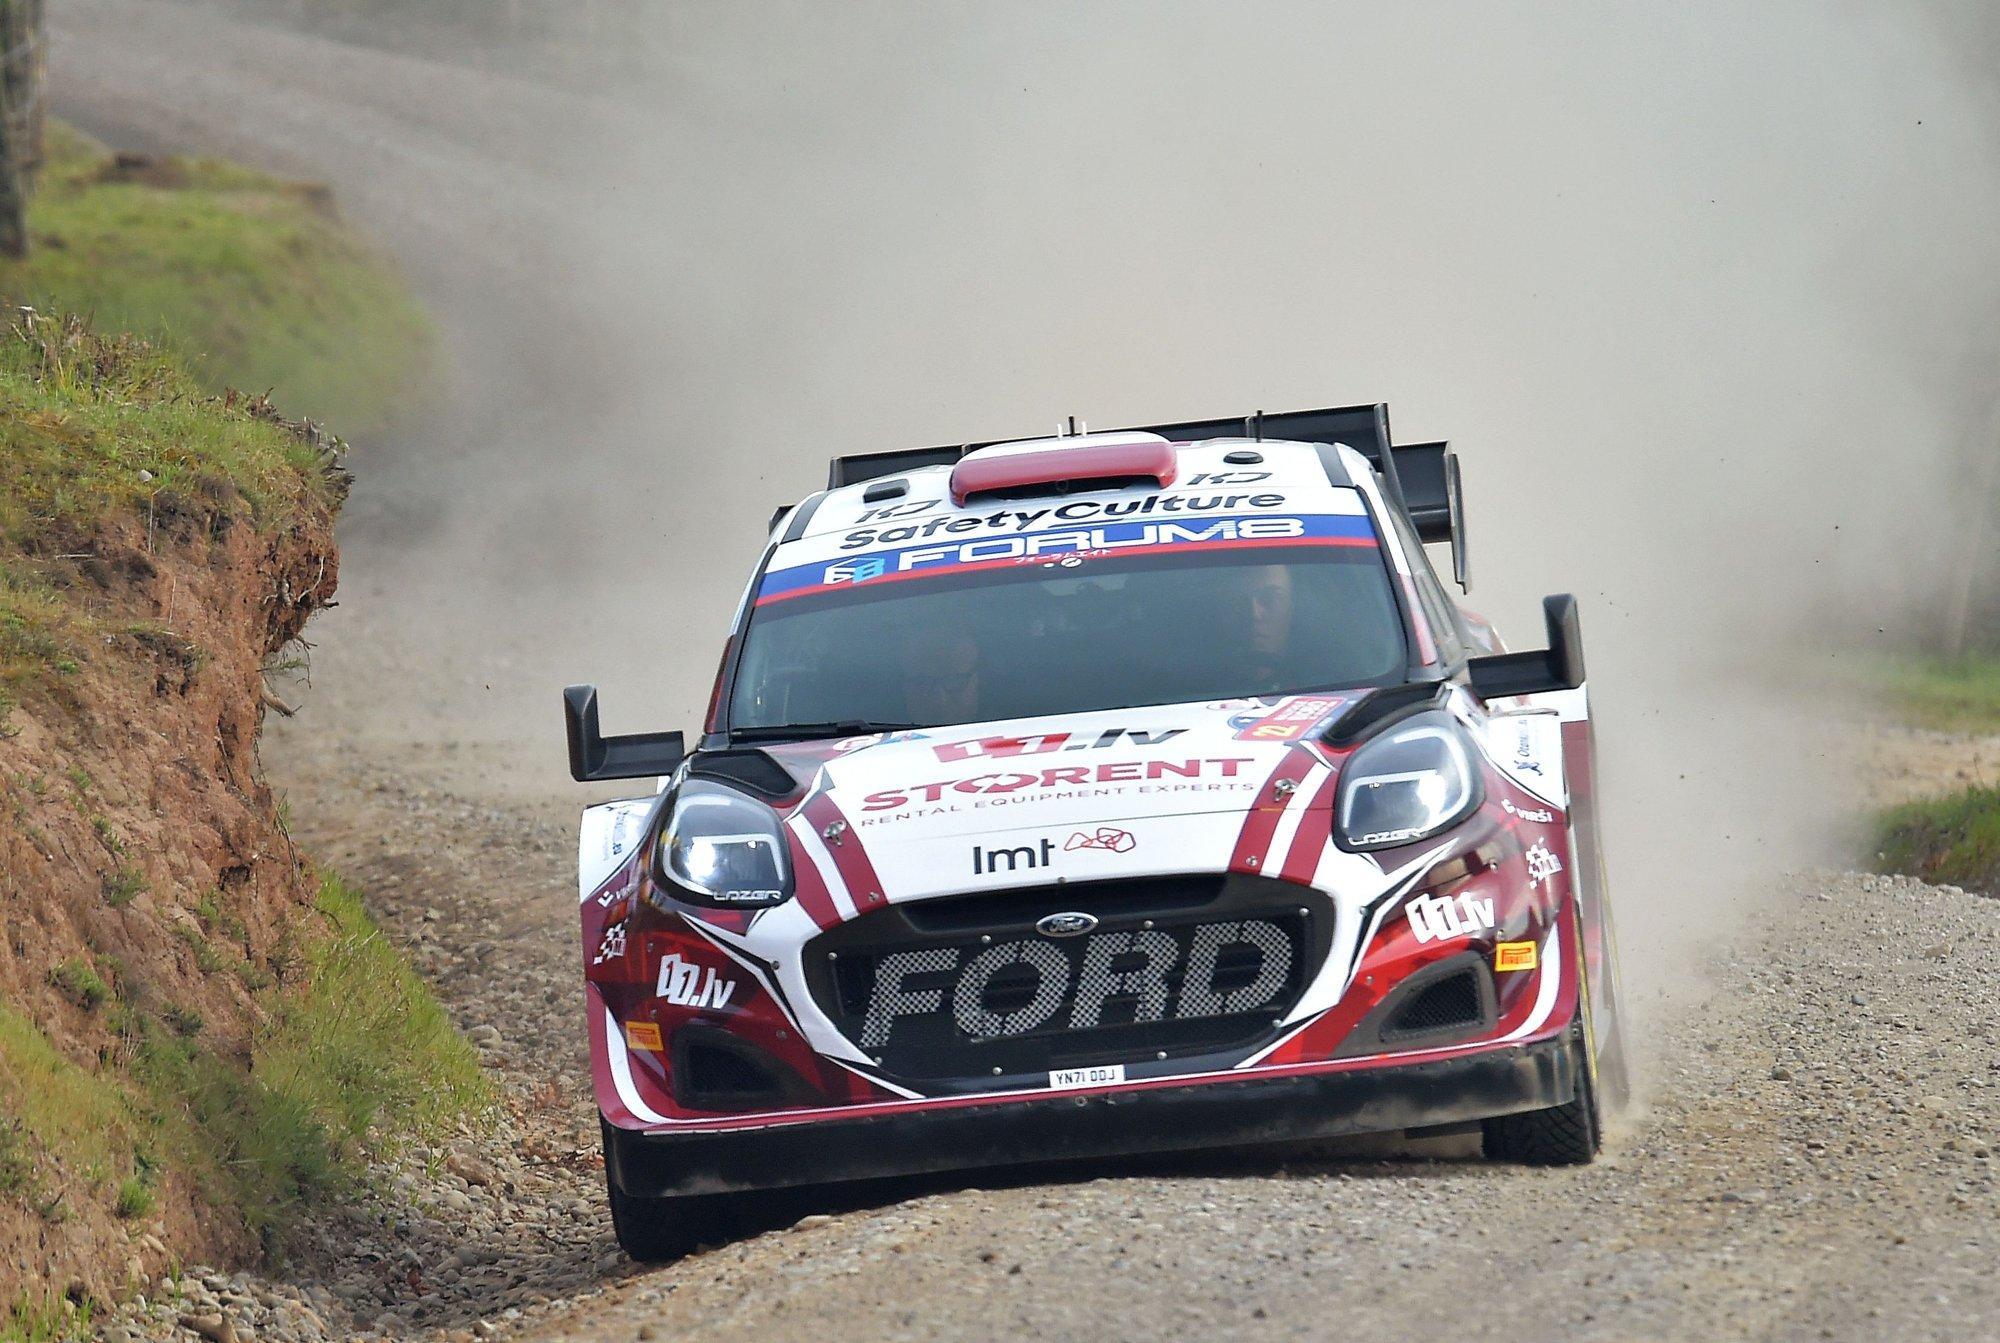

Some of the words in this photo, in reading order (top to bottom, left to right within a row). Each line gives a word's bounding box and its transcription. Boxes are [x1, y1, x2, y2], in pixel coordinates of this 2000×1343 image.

[840, 493, 1286, 549] SafetyCulture
[898, 516, 1305, 571] FORUM8
[932, 728, 1190, 762] 11.lv
[861, 758, 1255, 811] STORENT
[861, 805, 962, 827] RENTAL
[974, 787, 1126, 809] EQUIPMENT
[1139, 783, 1254, 794] EXPERTS
[973, 838, 1055, 875] lmt
[858, 920, 1293, 1047] FORD
[1056, 1071, 1085, 1084] YN71
